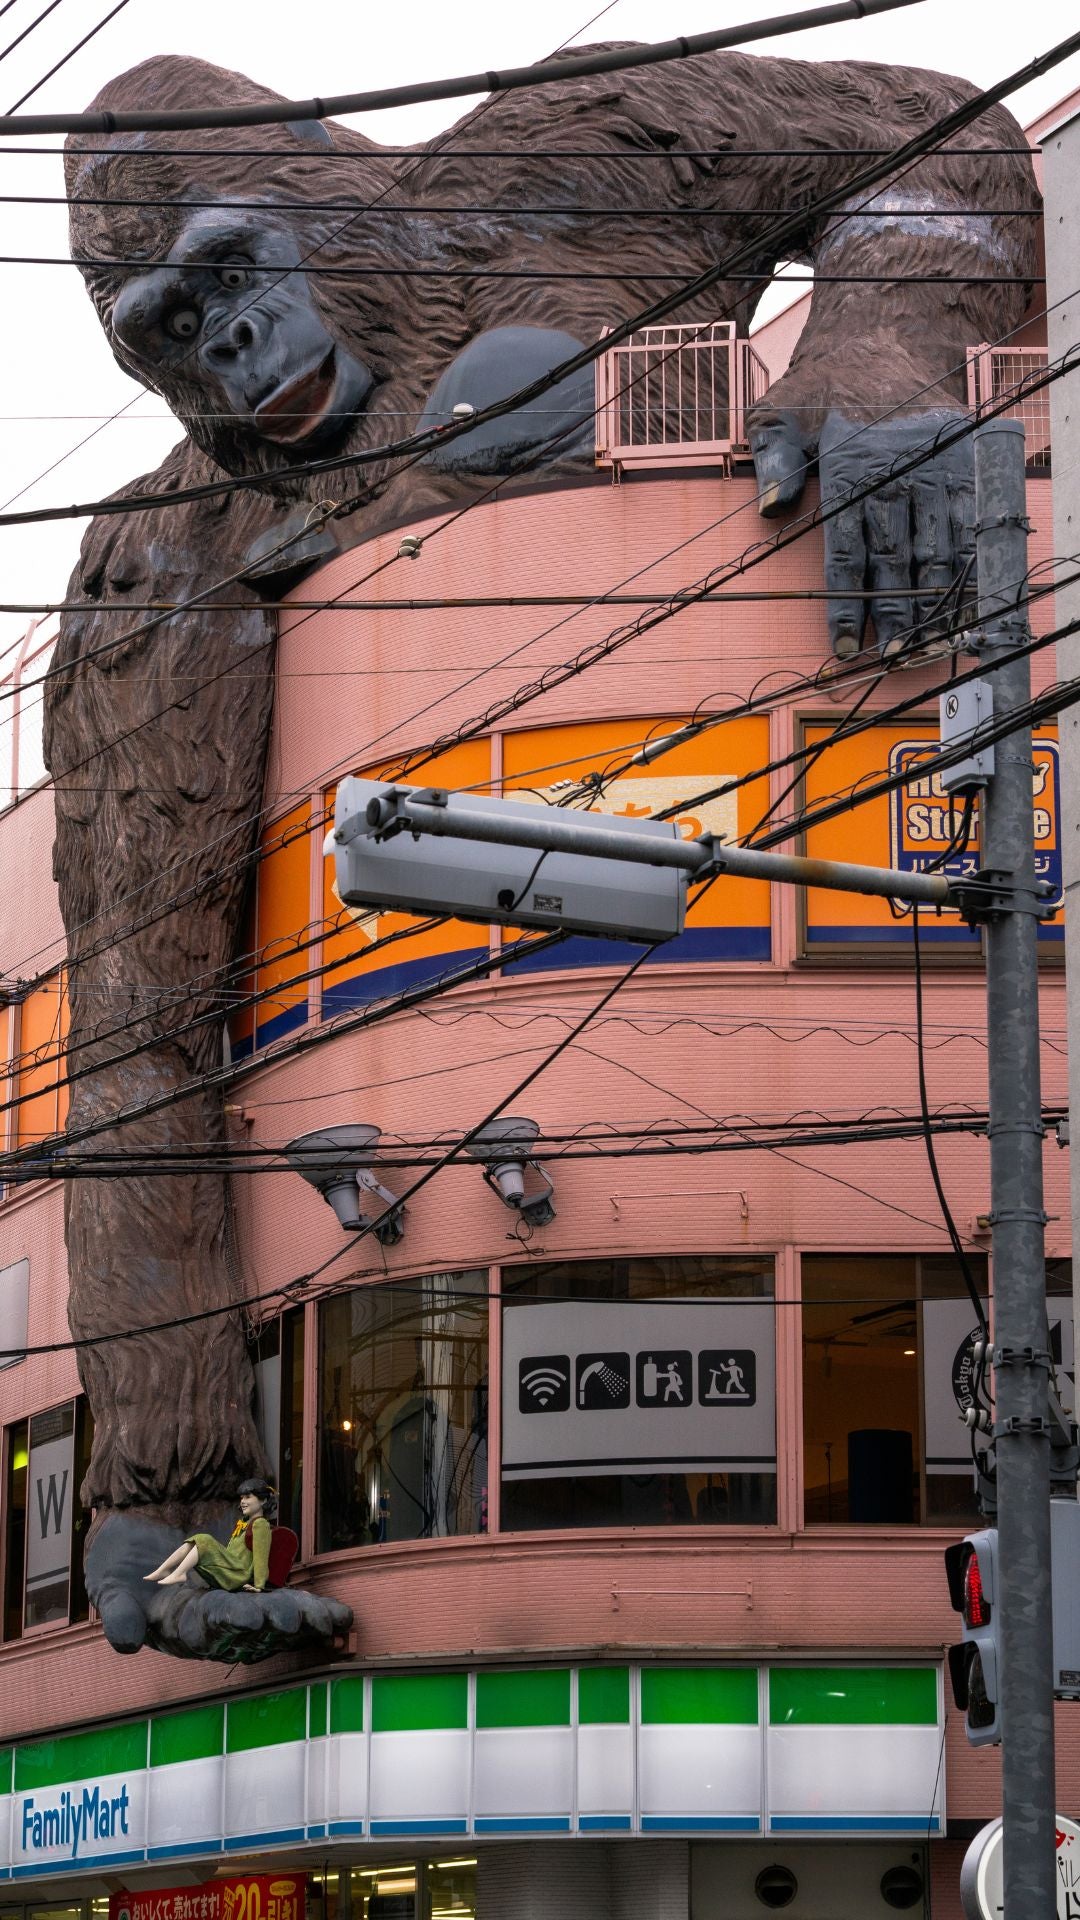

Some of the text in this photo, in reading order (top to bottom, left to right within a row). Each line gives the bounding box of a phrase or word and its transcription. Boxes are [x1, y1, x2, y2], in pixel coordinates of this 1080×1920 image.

[907, 804, 1052, 841] Store
[955, 1356, 974, 1411] Tokyo
[36, 1470, 69, 1539] W
[22, 1784, 129, 1858] FamilyMart
